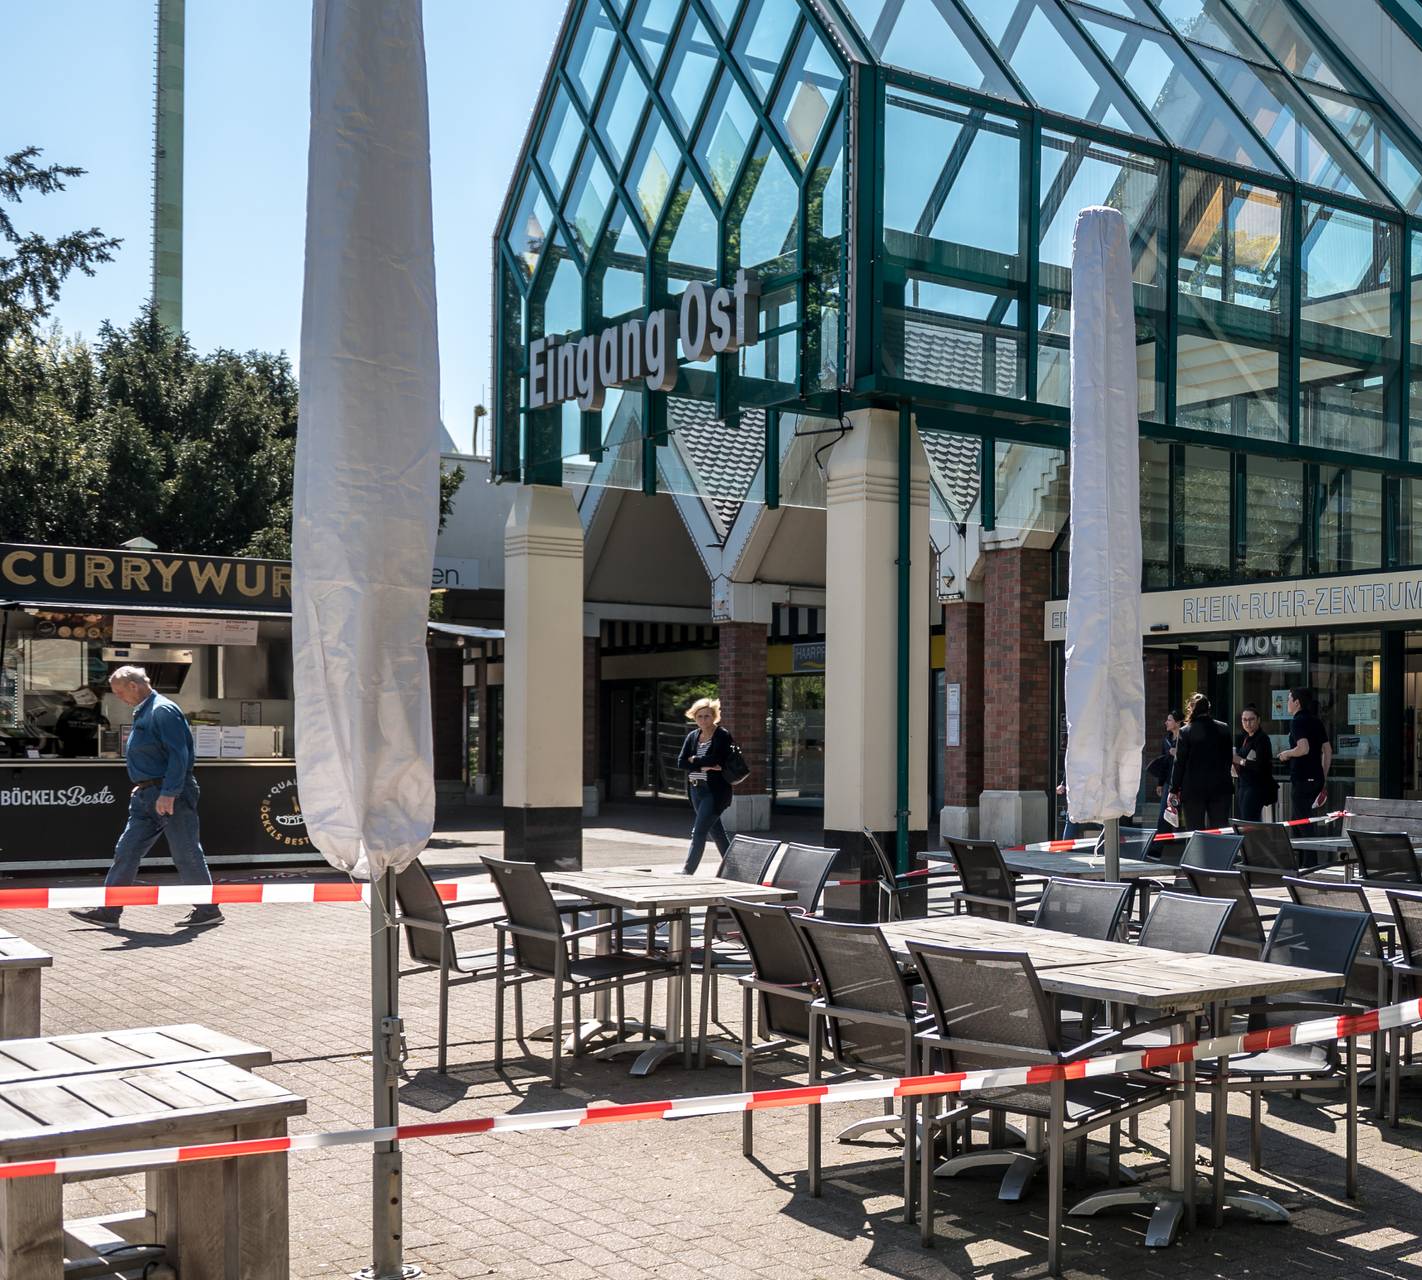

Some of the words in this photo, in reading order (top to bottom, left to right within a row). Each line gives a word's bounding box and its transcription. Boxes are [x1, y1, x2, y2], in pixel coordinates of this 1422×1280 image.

[530, 308, 672, 411] Eingang
[680, 268, 754, 362] Ost
[1051, 611, 1067, 629] EI
